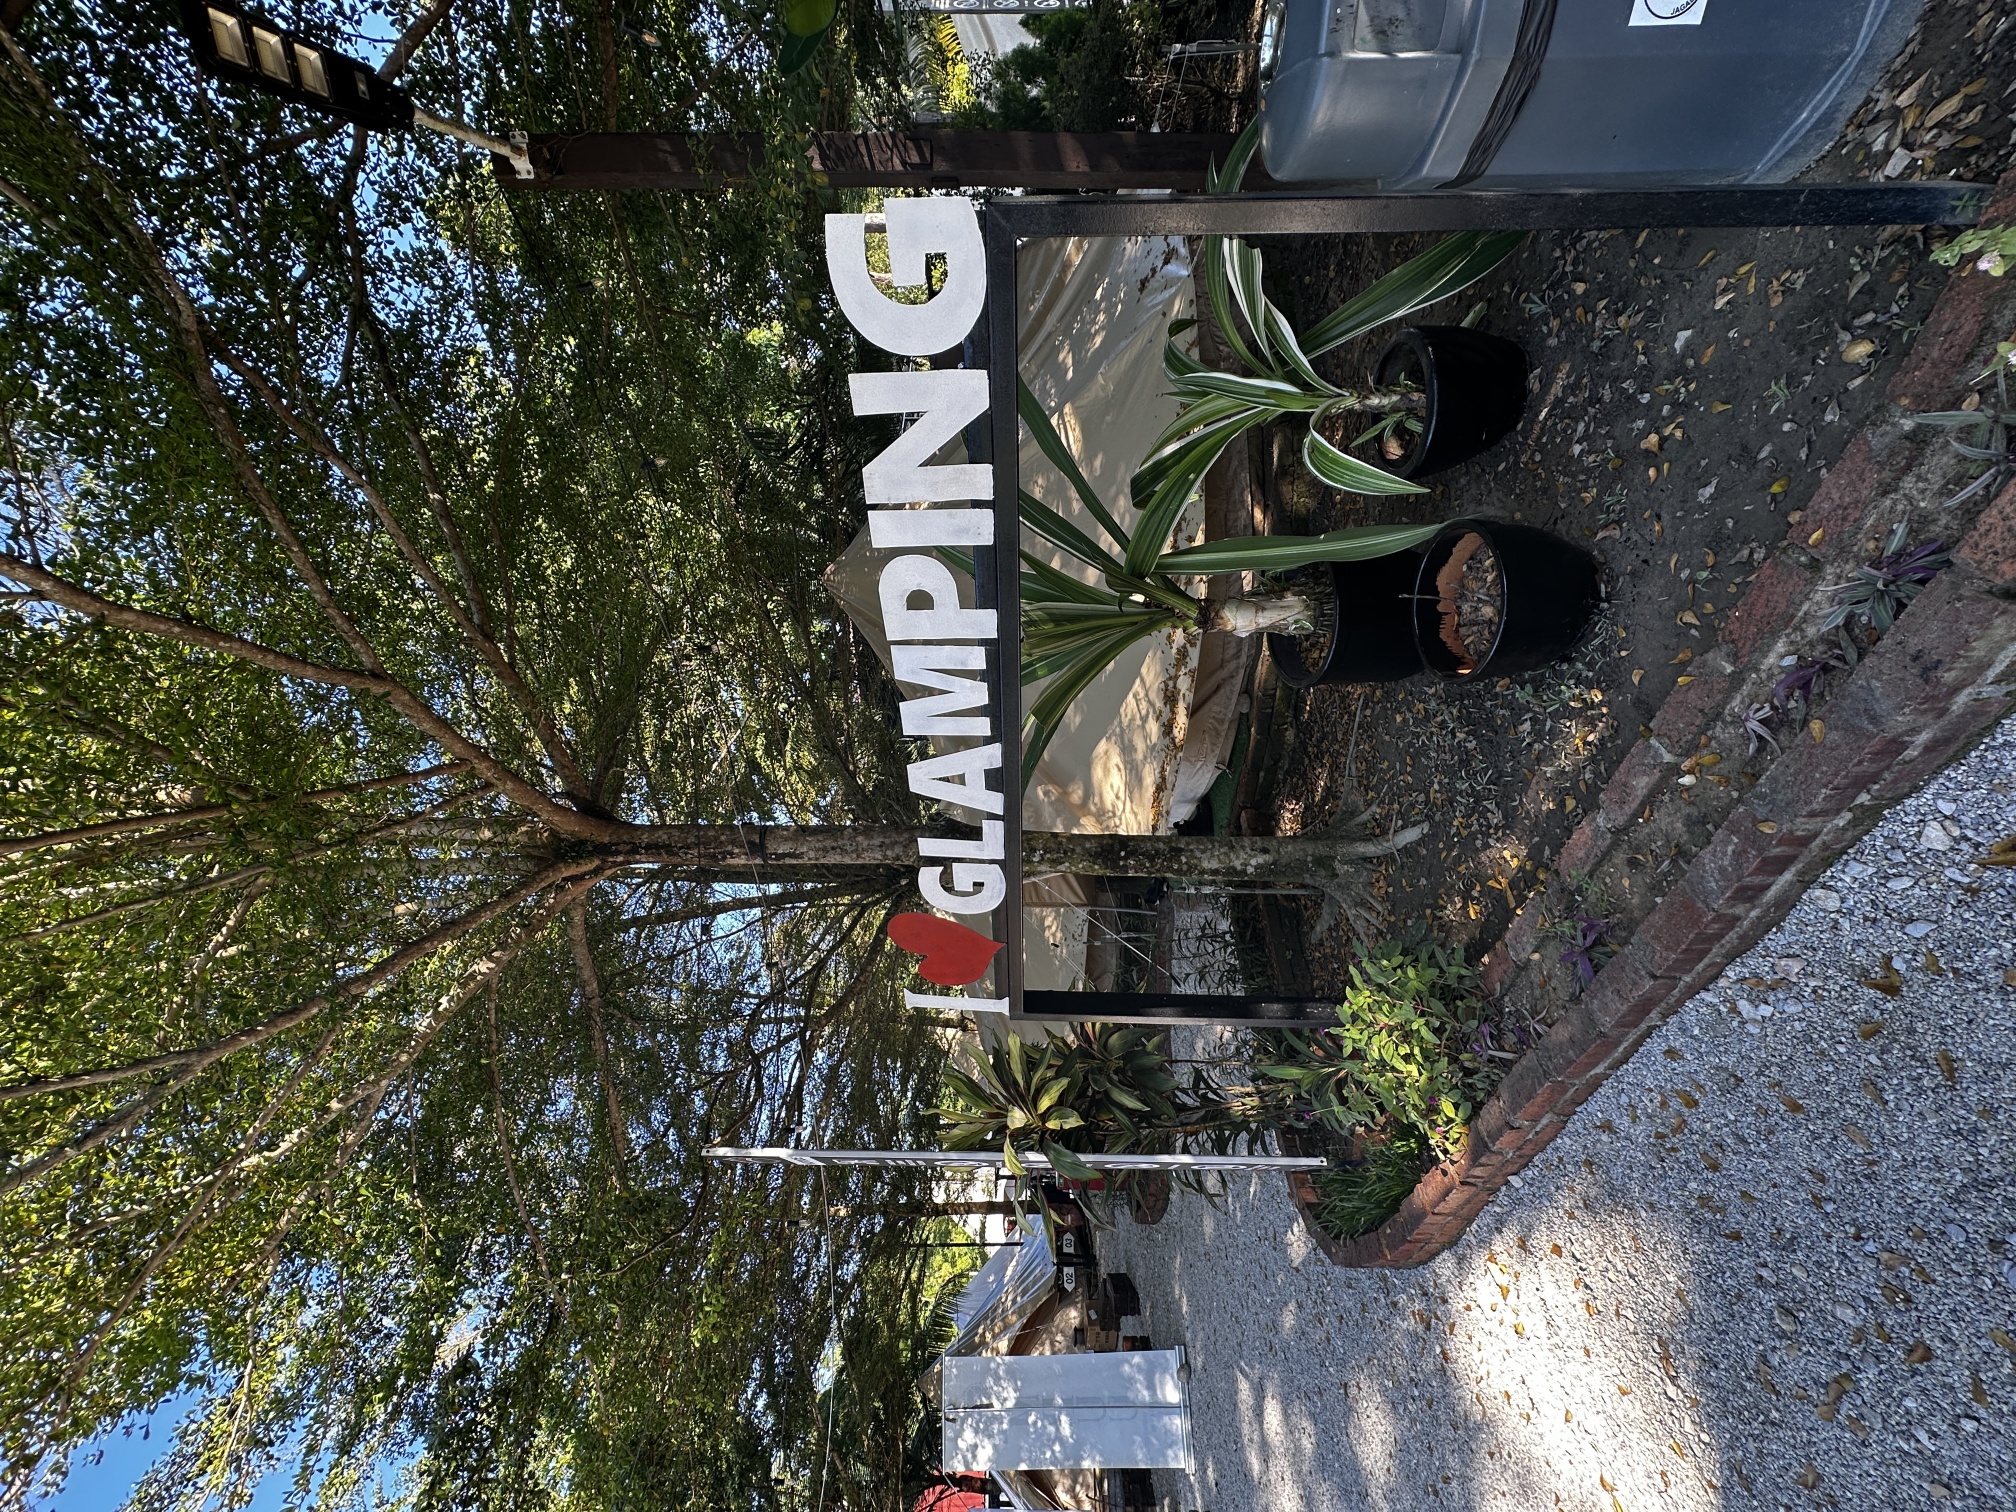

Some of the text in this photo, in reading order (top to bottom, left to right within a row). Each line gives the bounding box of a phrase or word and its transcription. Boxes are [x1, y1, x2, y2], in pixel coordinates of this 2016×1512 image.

[825, 198, 1010, 1013] I GLAMPING
[1065, 1238, 1073, 1248] 03
[1066, 1272, 1074, 1285] 02
